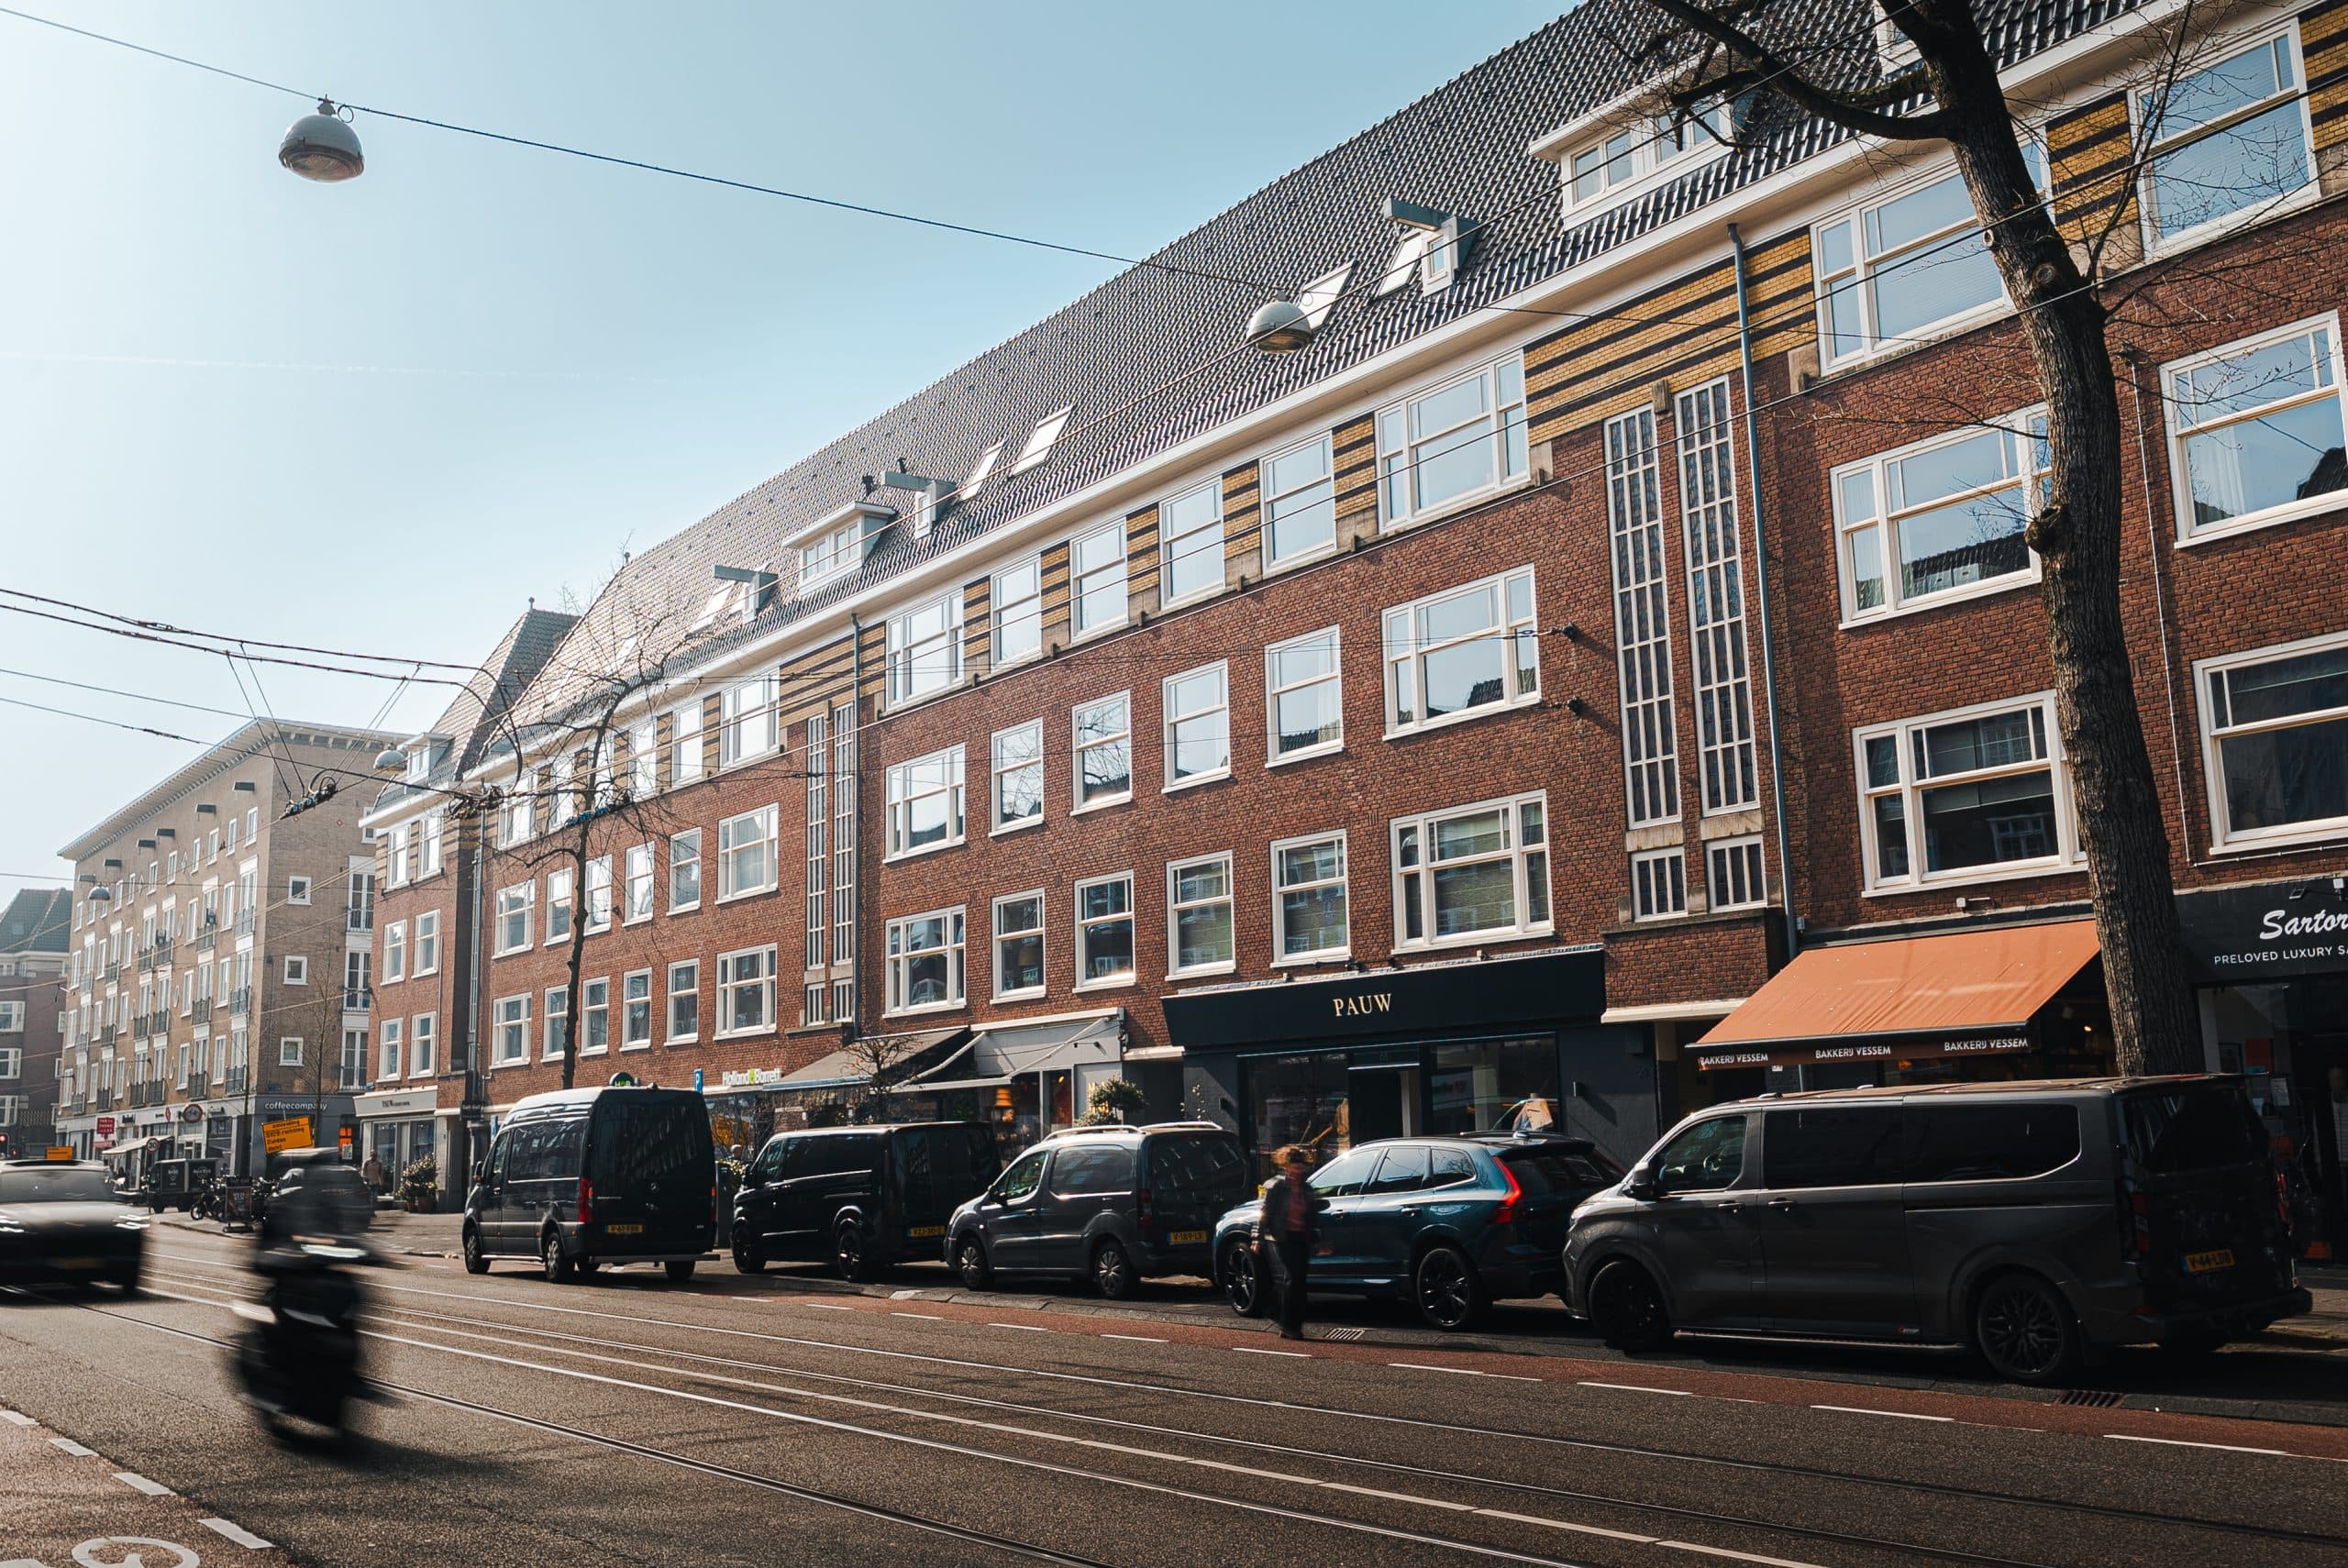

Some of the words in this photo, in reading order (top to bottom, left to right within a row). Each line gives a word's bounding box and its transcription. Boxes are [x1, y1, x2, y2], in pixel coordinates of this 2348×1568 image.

[2214, 951, 2278, 966] PRELOVED
[2283, 946, 2332, 959] LUXURY
[2338, 944, 2348, 955] S
[1333, 993, 1391, 1017] PAUW
[1815, 1047, 1854, 1059] BAKKERIJ
[1855, 1045, 1891, 1056] VESSEM
[1944, 1040, 1988, 1052] BAKKERIJ
[1988, 1037, 2029, 1049] VESSEM
[1735, 1053, 1768, 1063] VESSEM
